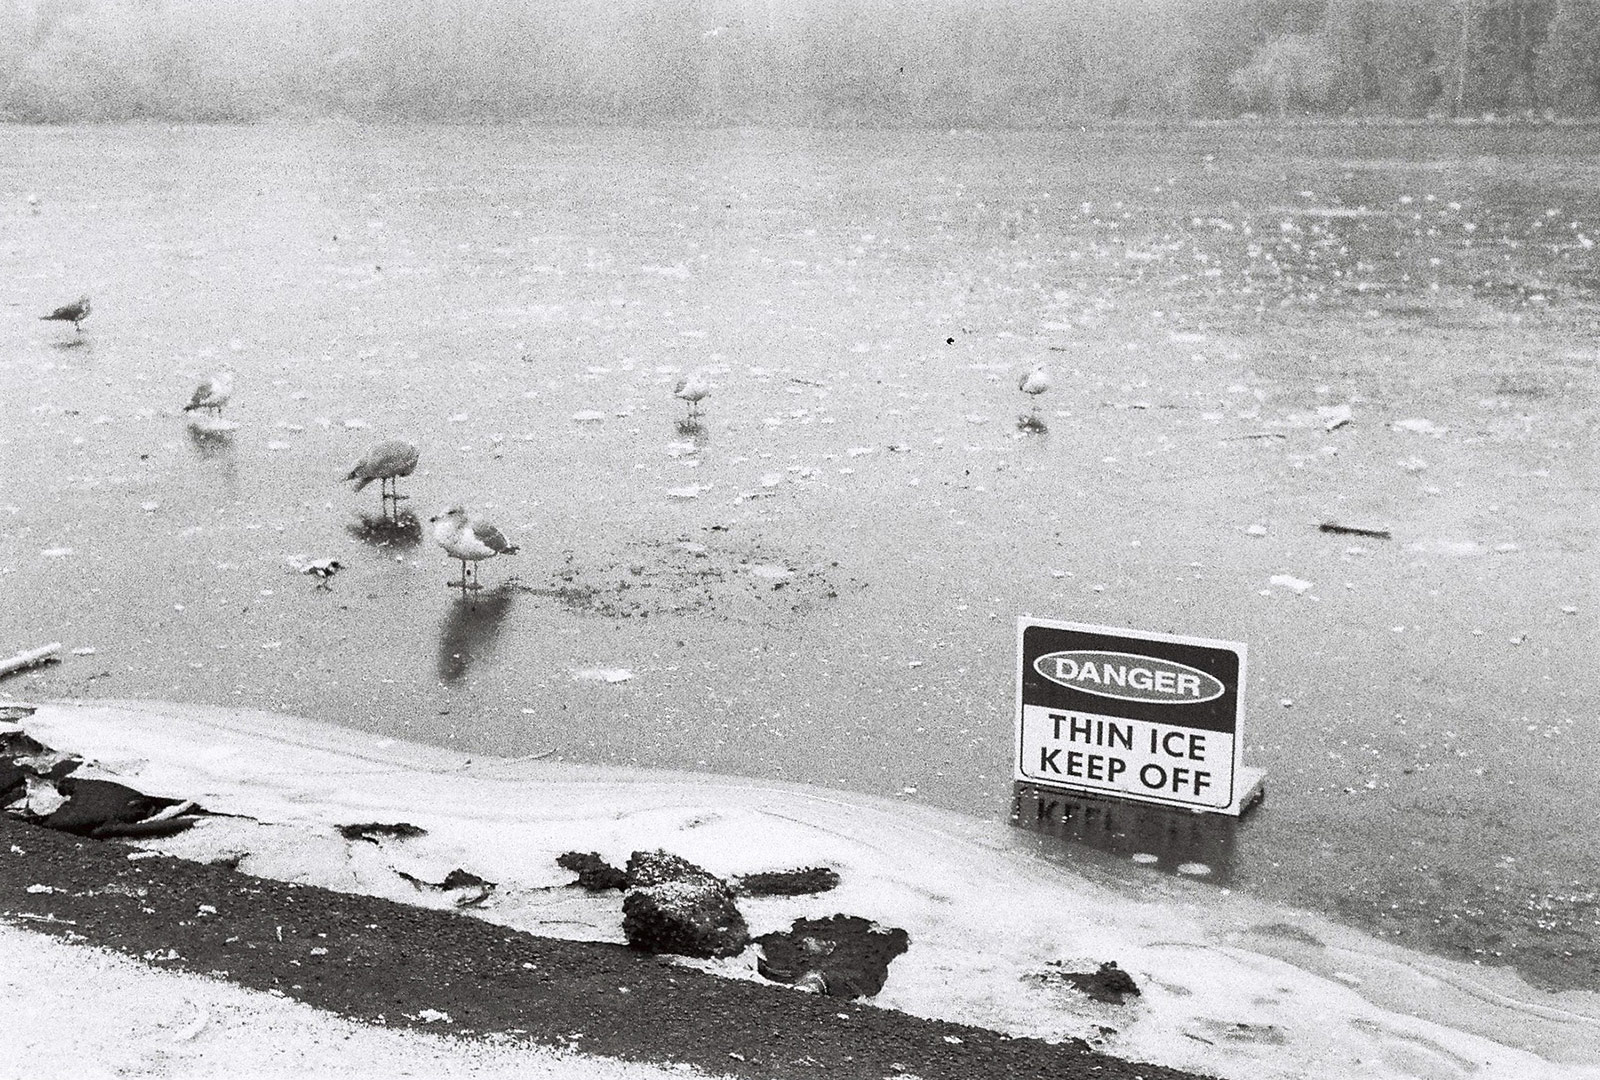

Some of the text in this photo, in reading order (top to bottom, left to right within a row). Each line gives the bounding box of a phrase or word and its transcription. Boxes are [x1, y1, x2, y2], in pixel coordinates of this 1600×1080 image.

[1055, 657, 1201, 697] DANGER
[1048, 713, 1206, 761] THIN ICE
[1040, 746, 1212, 796] KEEP OFF
